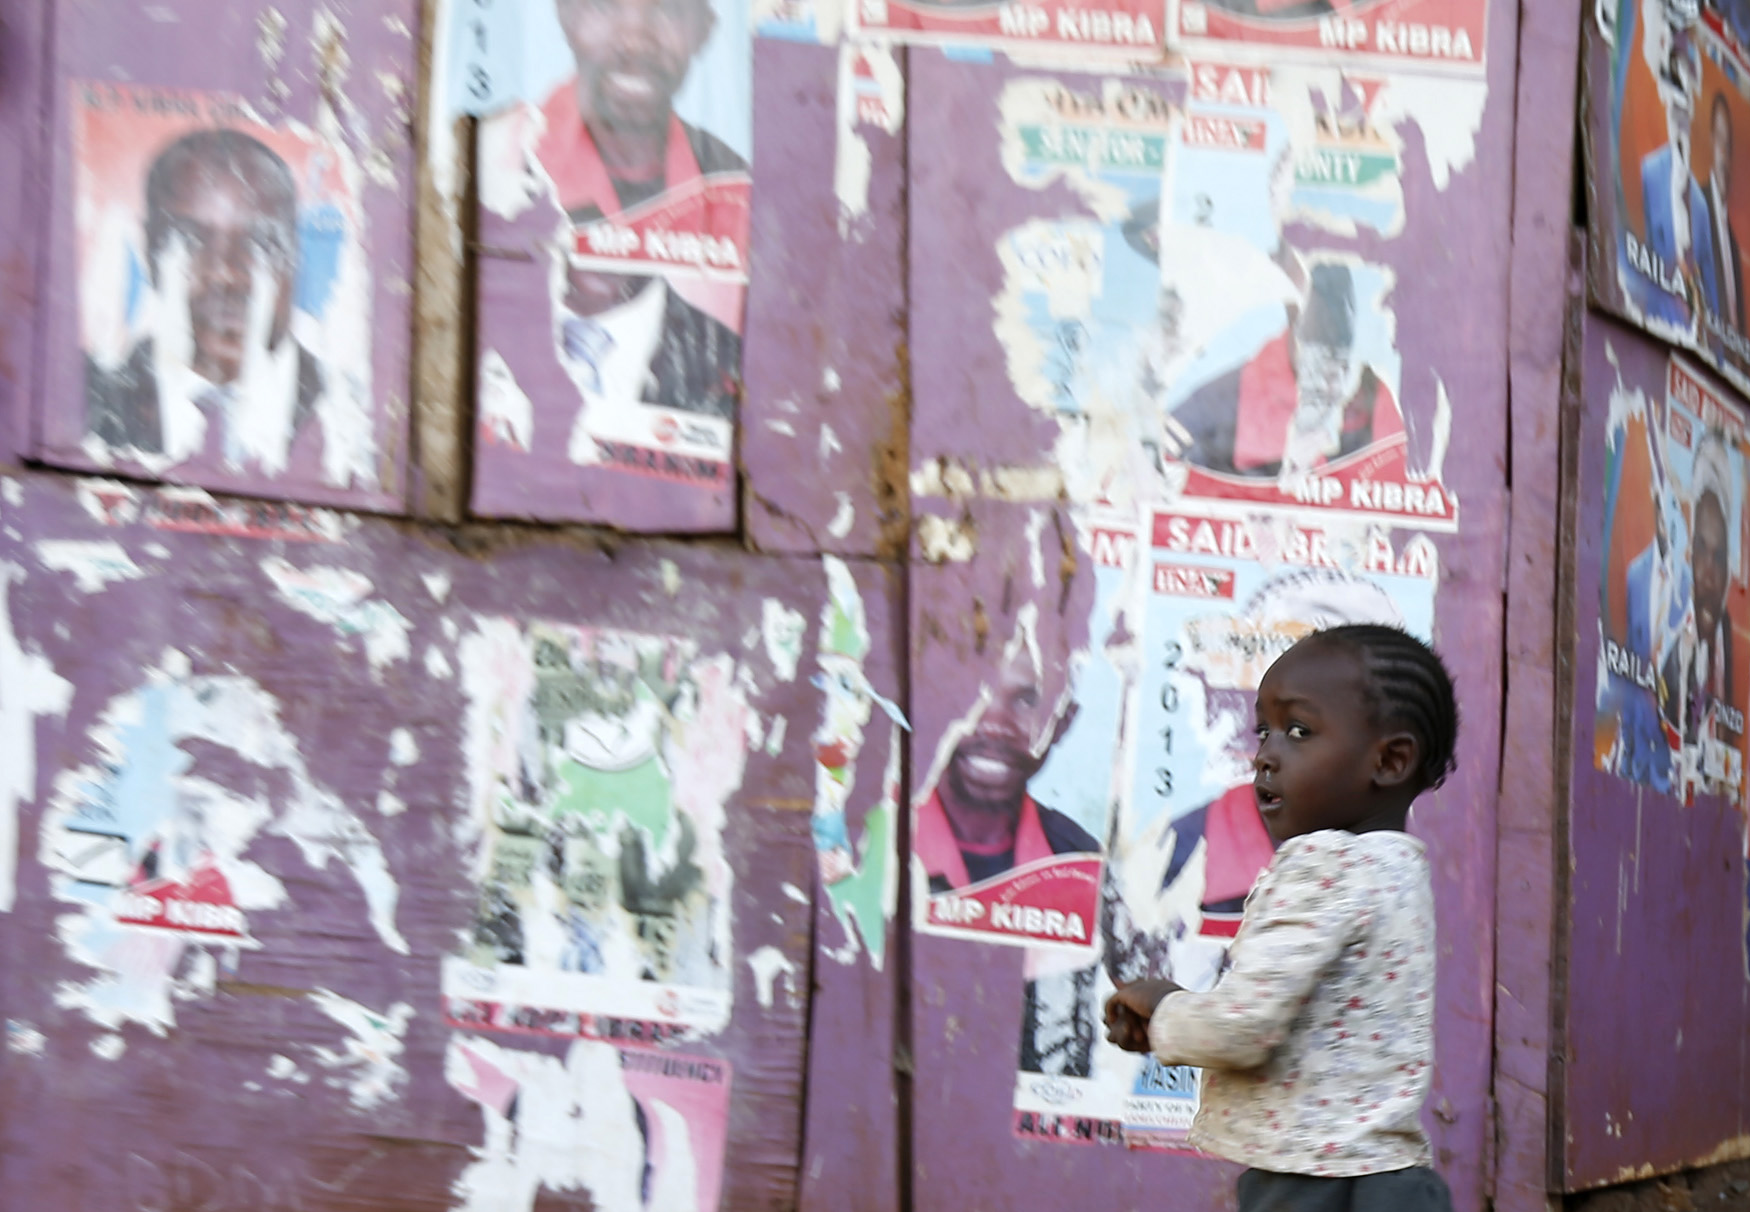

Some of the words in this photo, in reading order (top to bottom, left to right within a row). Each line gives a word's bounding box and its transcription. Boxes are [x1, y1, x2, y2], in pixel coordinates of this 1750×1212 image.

[999, 4, 1049, 38] MP
[1056, 7, 1158, 45] KIBRA
[1319, 16, 1368, 49] MP
[1375, 20, 1474, 60] KIBRA
[643, 226, 742, 270] KIBRA
[1625, 230, 1688, 302] RAILA
[1350, 478, 1448, 517] KIBRA
[1606, 638, 1658, 693] RAILA
[1154, 638, 1184, 799] 2013
[933, 895, 987, 925] MP
[989, 900, 1088, 941] KIBRA
